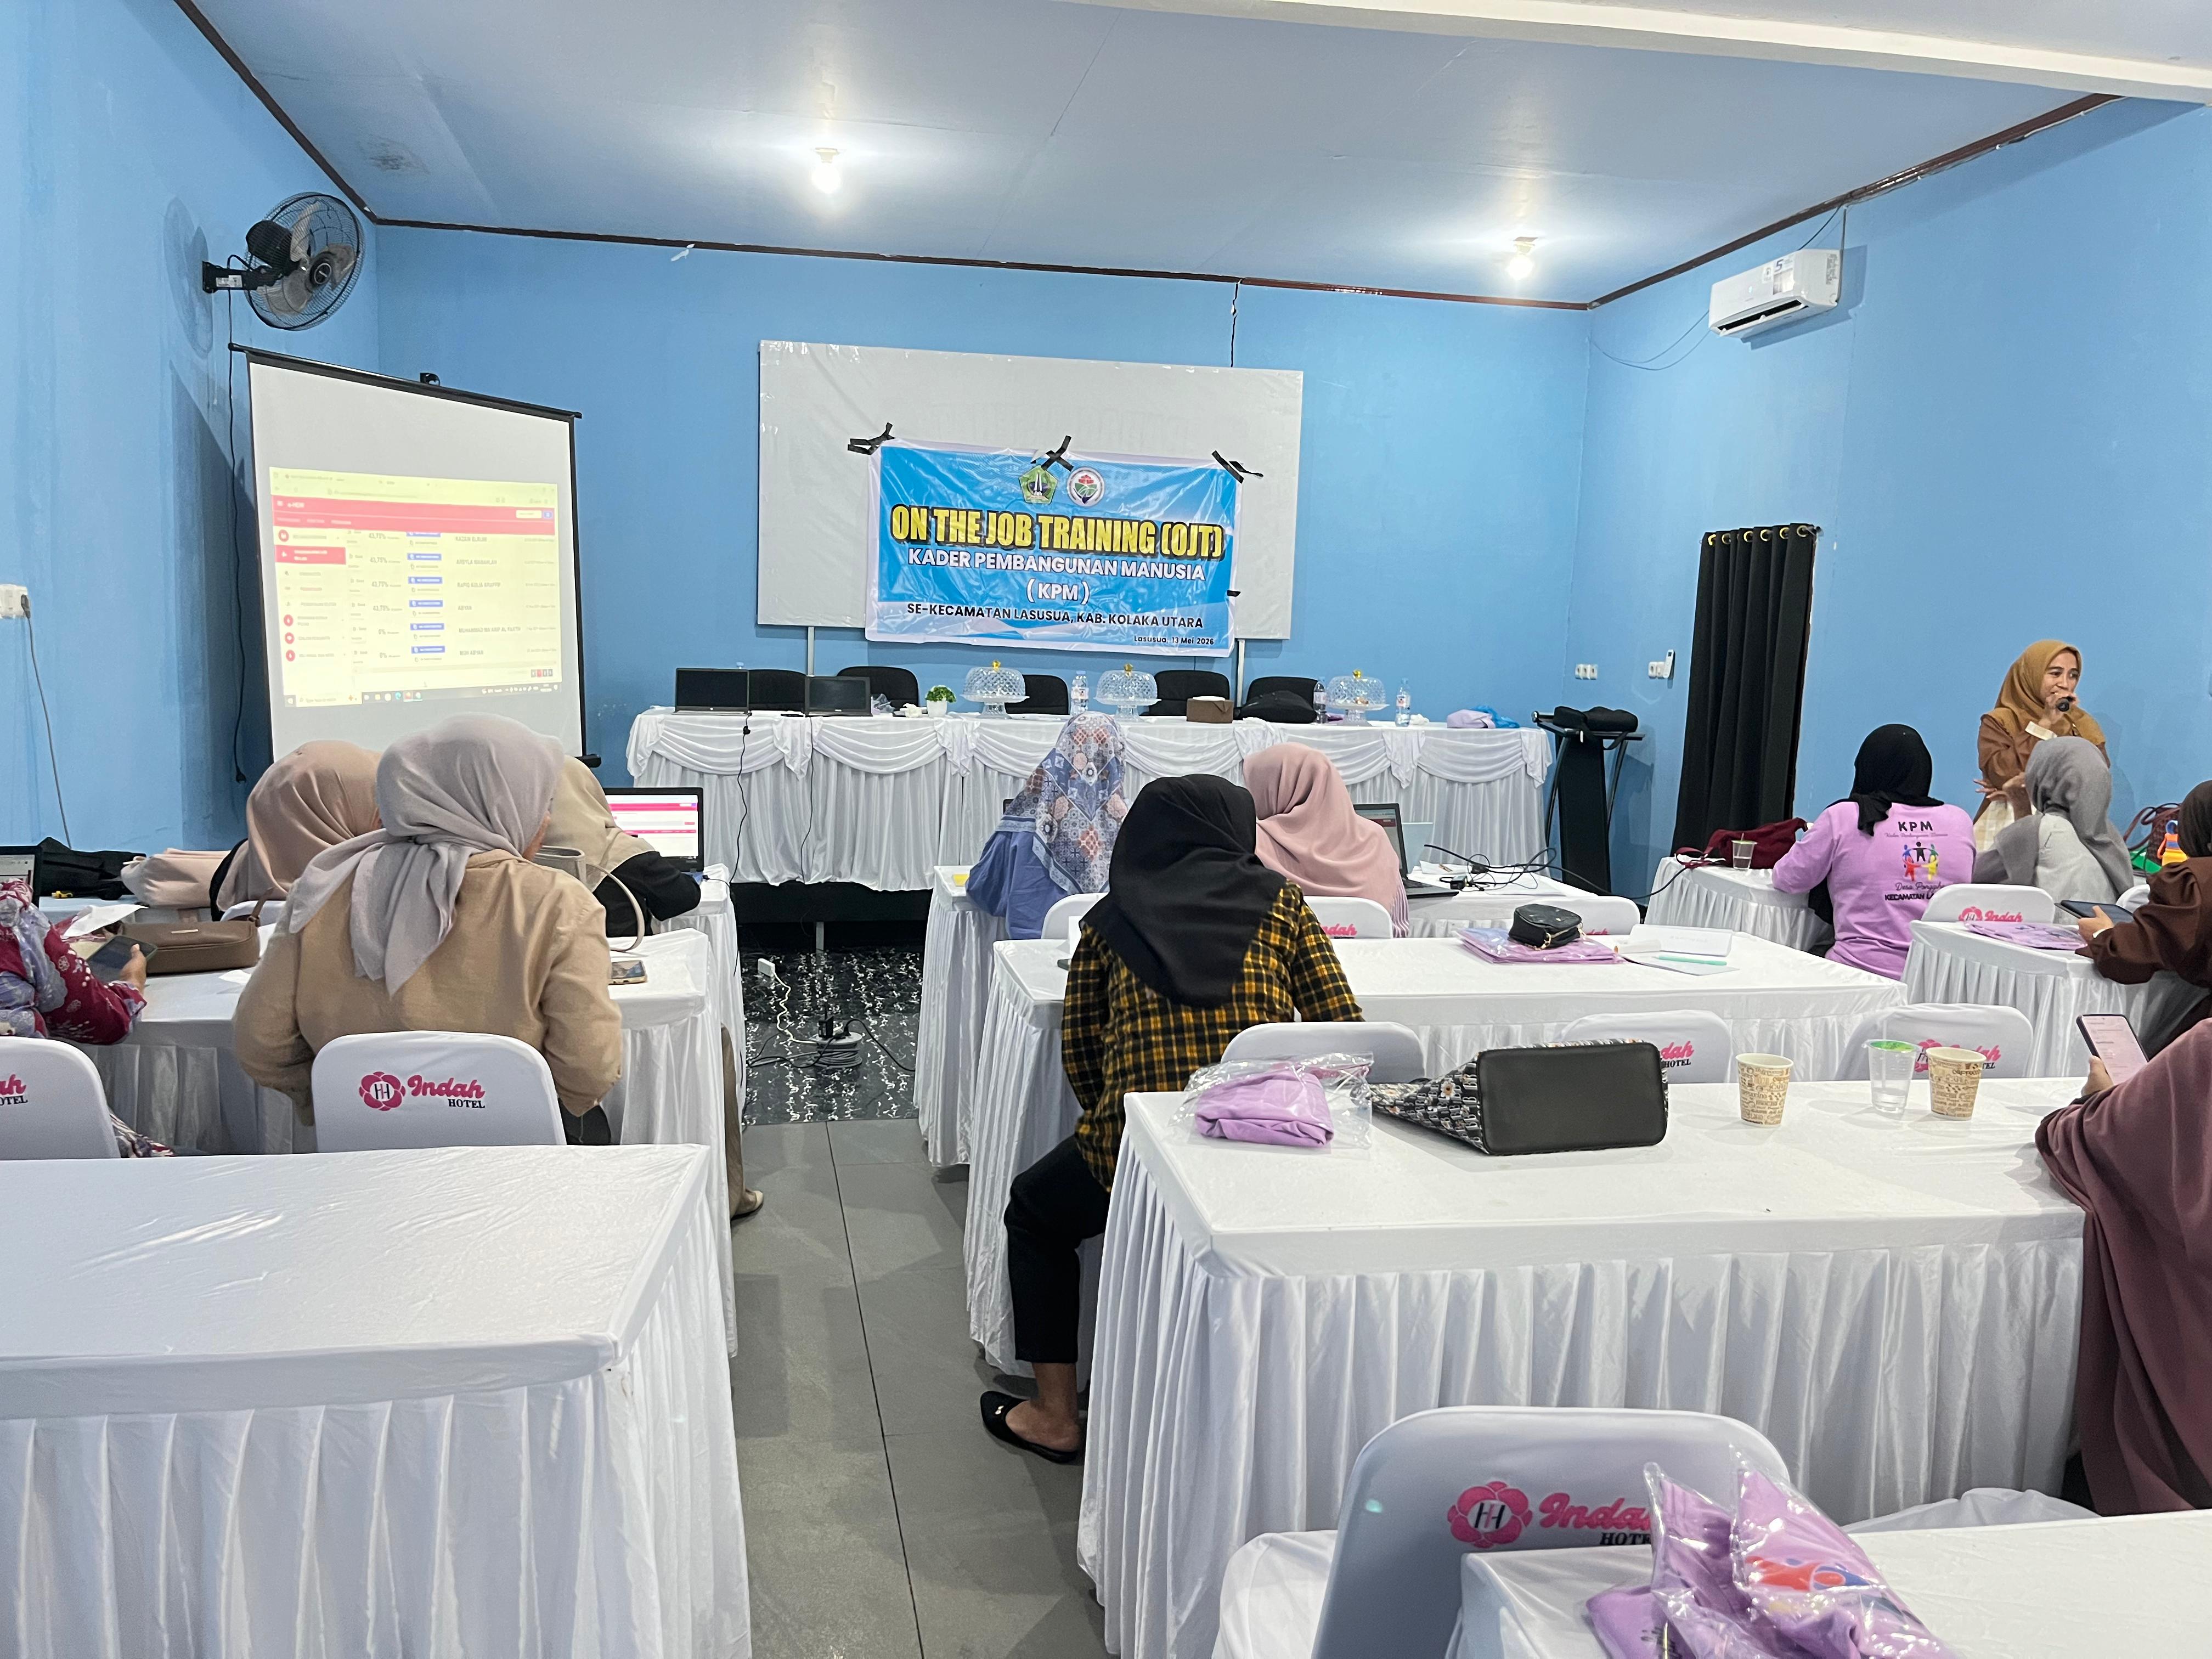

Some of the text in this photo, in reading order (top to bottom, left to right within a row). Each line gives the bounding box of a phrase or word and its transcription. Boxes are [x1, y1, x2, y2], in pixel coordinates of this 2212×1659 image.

[891, 505, 1223, 557] ON THE JOB TRAINING (OJT)
[909, 548, 1206, 581] KADER PEMBANGUNAN MANUSIA
[907, 603, 1203, 628] SE-KECAMATAN LASUSUA, KAB. KOLAKA UTARA
[1134, 635, 1169, 644] Lasusua,
[1898, 821, 1933, 832] KPM
[1984, 910, 2023, 922] Indah
[1322, 923, 1358, 936] ndah
[1661, 1040, 1695, 1060] dah
[407, 1075, 486, 1099] Indah
[447, 1098, 486, 1109] HOTEL
[1599, 1532, 1652, 1545] HOTE
